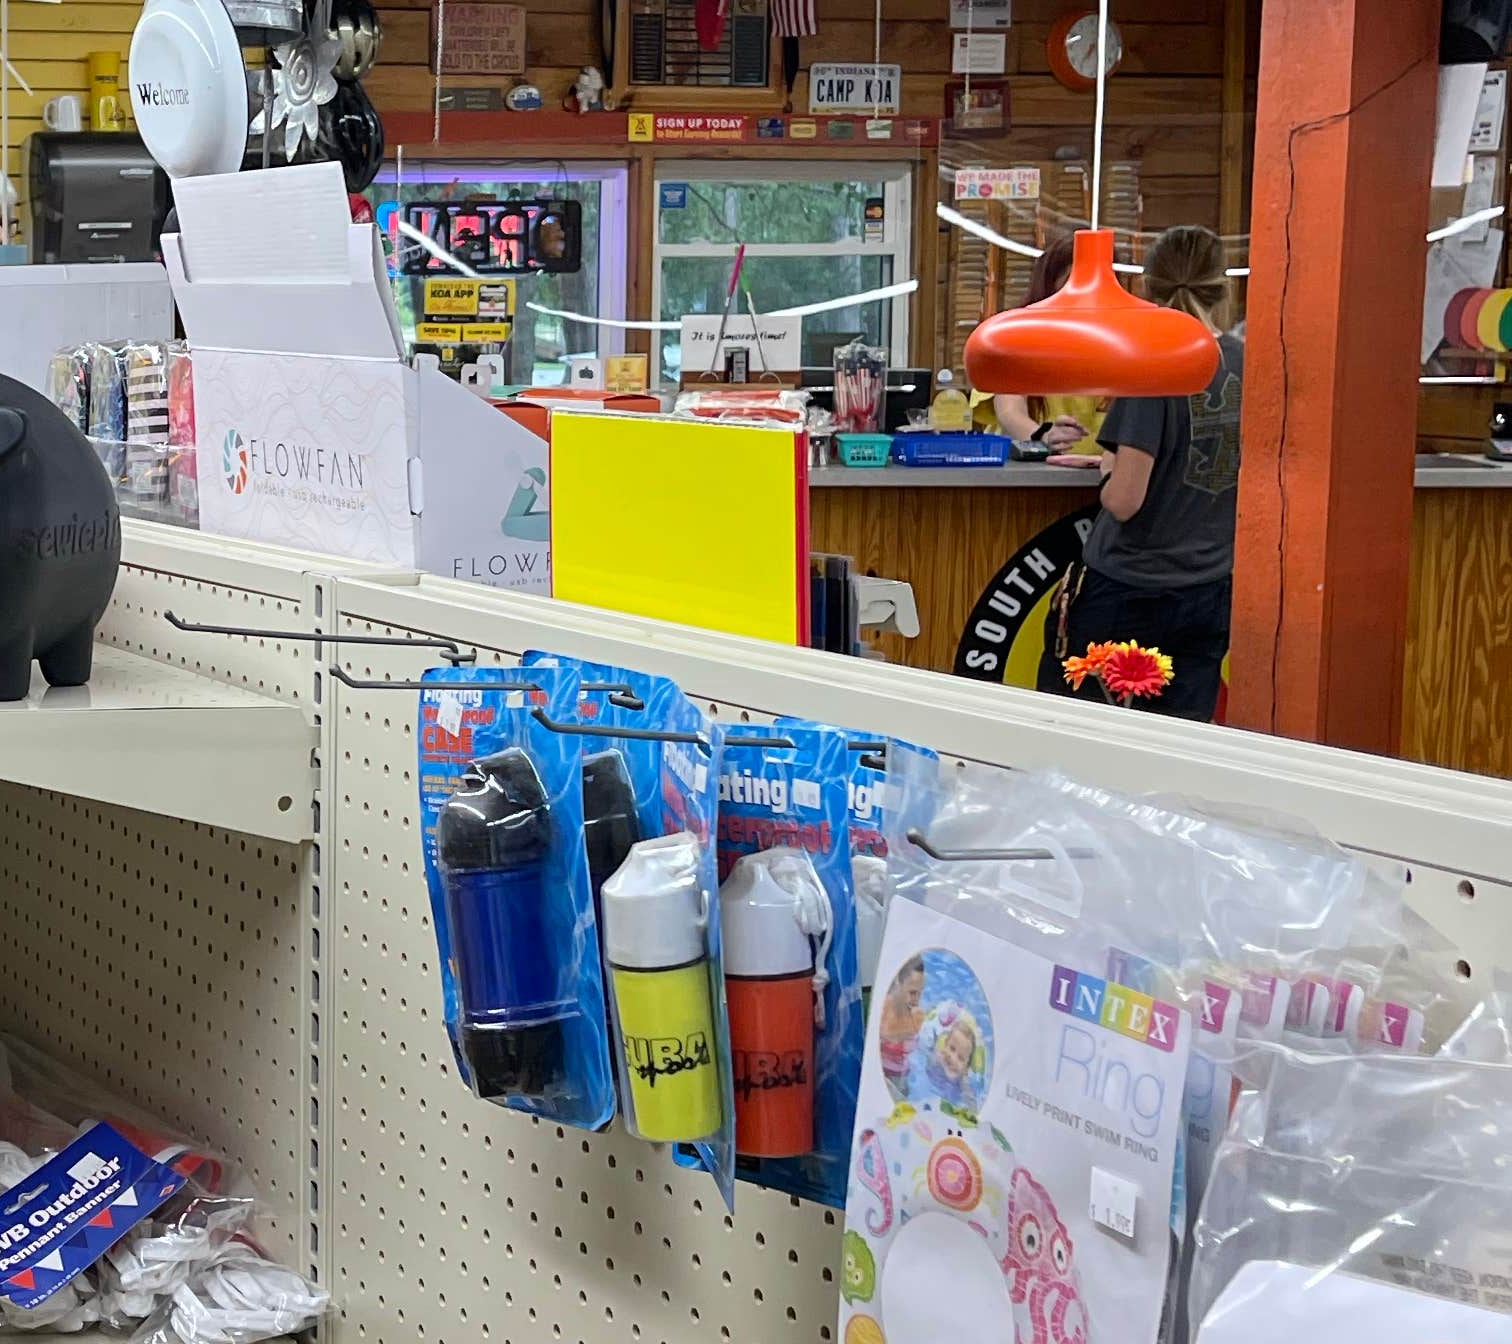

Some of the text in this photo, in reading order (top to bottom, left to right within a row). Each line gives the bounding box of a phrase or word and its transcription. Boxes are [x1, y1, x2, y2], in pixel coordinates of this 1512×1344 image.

[137, 83, 190, 106] Welcome
[816, 79, 854, 102] CAMP
[656, 118, 743, 128] SIGN UP TODAY
[978, 171, 1015, 182] MADE
[431, 289, 474, 298] KOA APP
[250, 439, 364, 489] FLOWFAN
[965, 547, 1057, 671] SOUTH
[719, 768, 787, 814] ating
[1055, 977, 1172, 1045] INTEX
[1055, 1023, 1166, 1138] Ring
[1006, 1082, 1159, 1163] LIVELY PRINT SWIM RING
[28, 1156, 122, 1228] Outdoor
[64, 1179, 122, 1225] Banner
